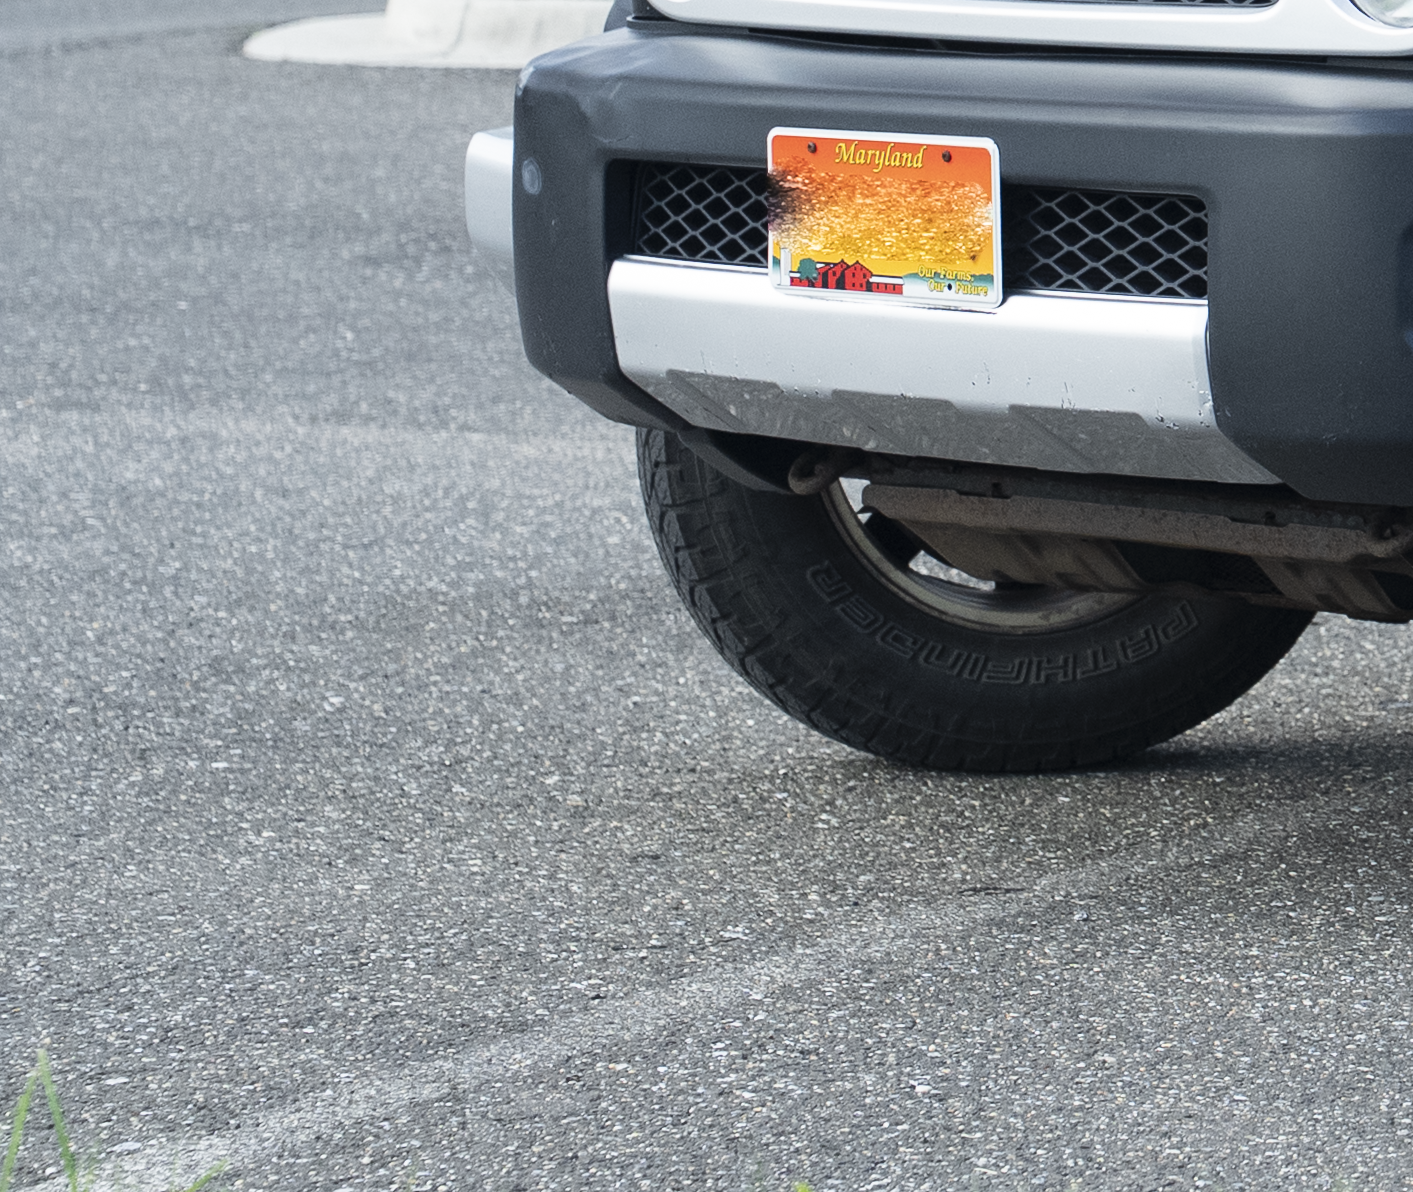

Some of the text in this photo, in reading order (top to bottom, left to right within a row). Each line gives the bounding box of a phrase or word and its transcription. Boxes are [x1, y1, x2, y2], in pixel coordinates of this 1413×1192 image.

[834, 140, 928, 173] Maryland
[918, 265, 936, 278] Our
[927, 279, 989, 297] Our Future
[806, 559, 1200, 685] PATHFINDER
